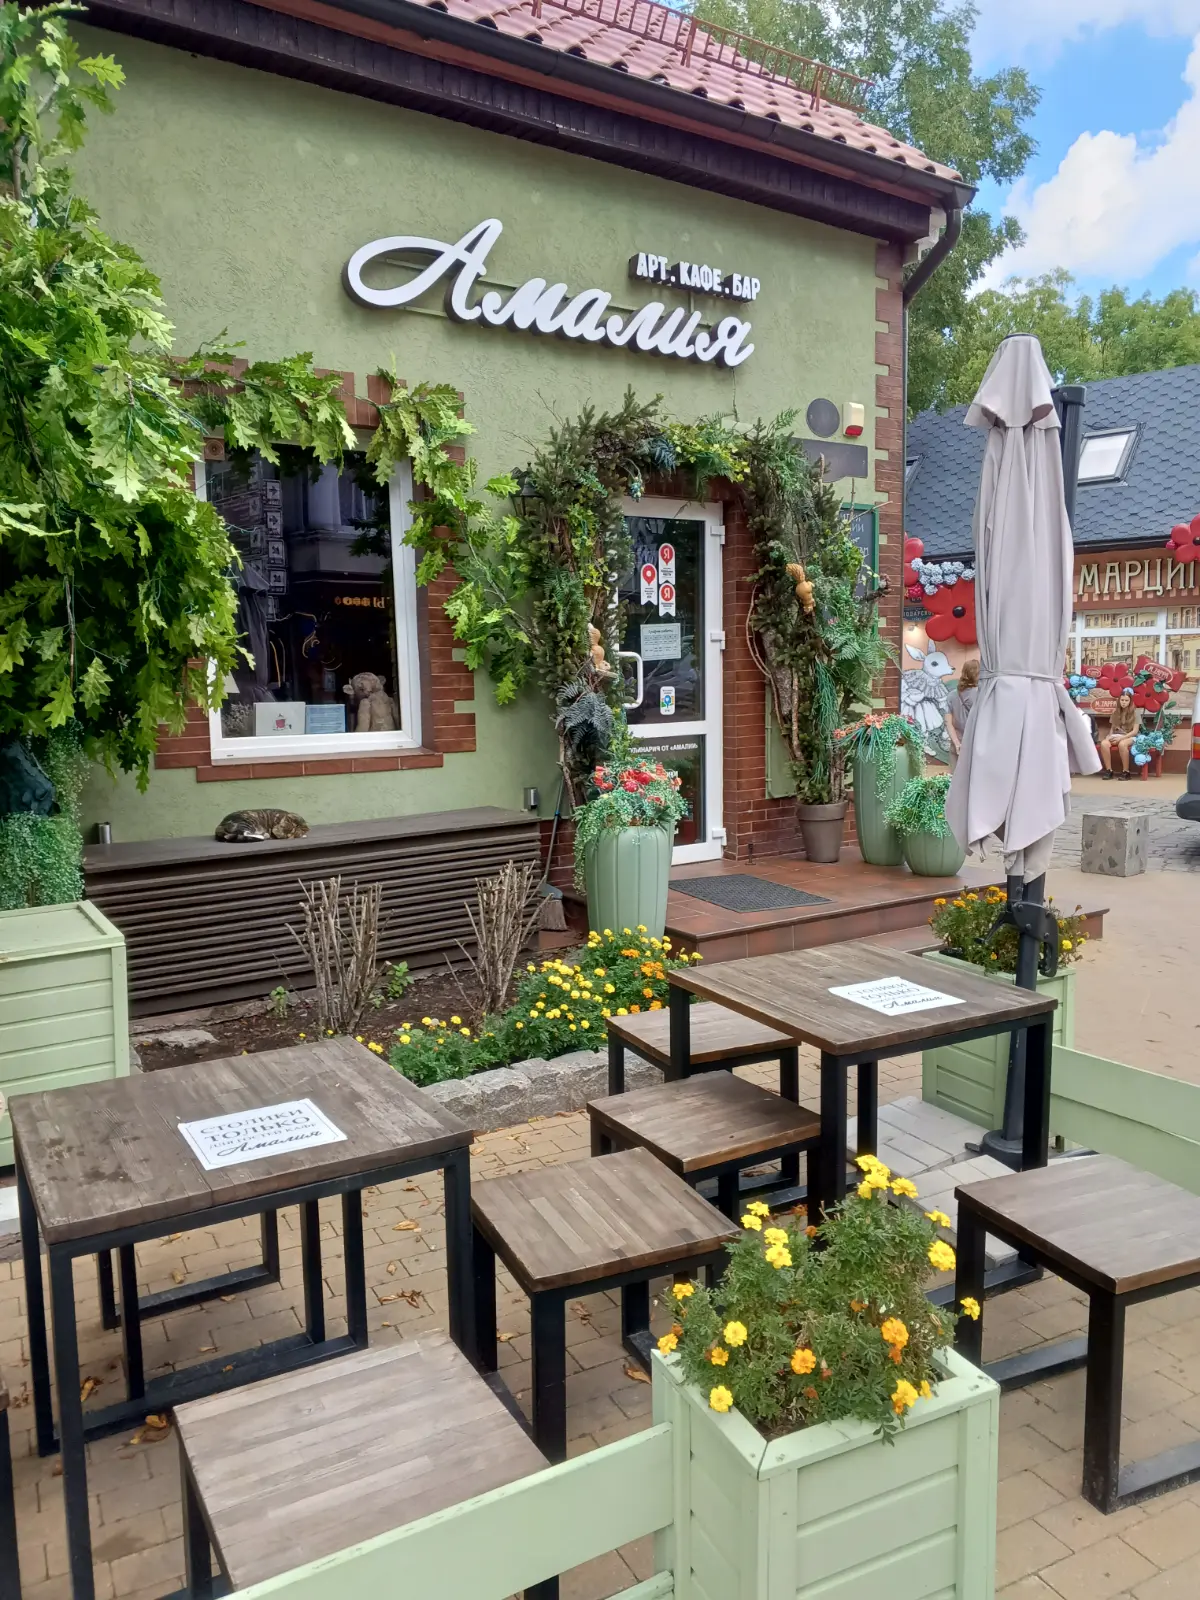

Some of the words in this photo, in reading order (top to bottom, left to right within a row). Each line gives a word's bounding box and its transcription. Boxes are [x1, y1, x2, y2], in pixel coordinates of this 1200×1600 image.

[346, 217, 755, 367] Амалия
[732, 272, 761, 301] БАР
[200, 1108, 304, 1135] СТОЛИКИ
[204, 1116, 311, 1143] ТОЛЬКО
[216, 1130, 323, 1157] Амалия
